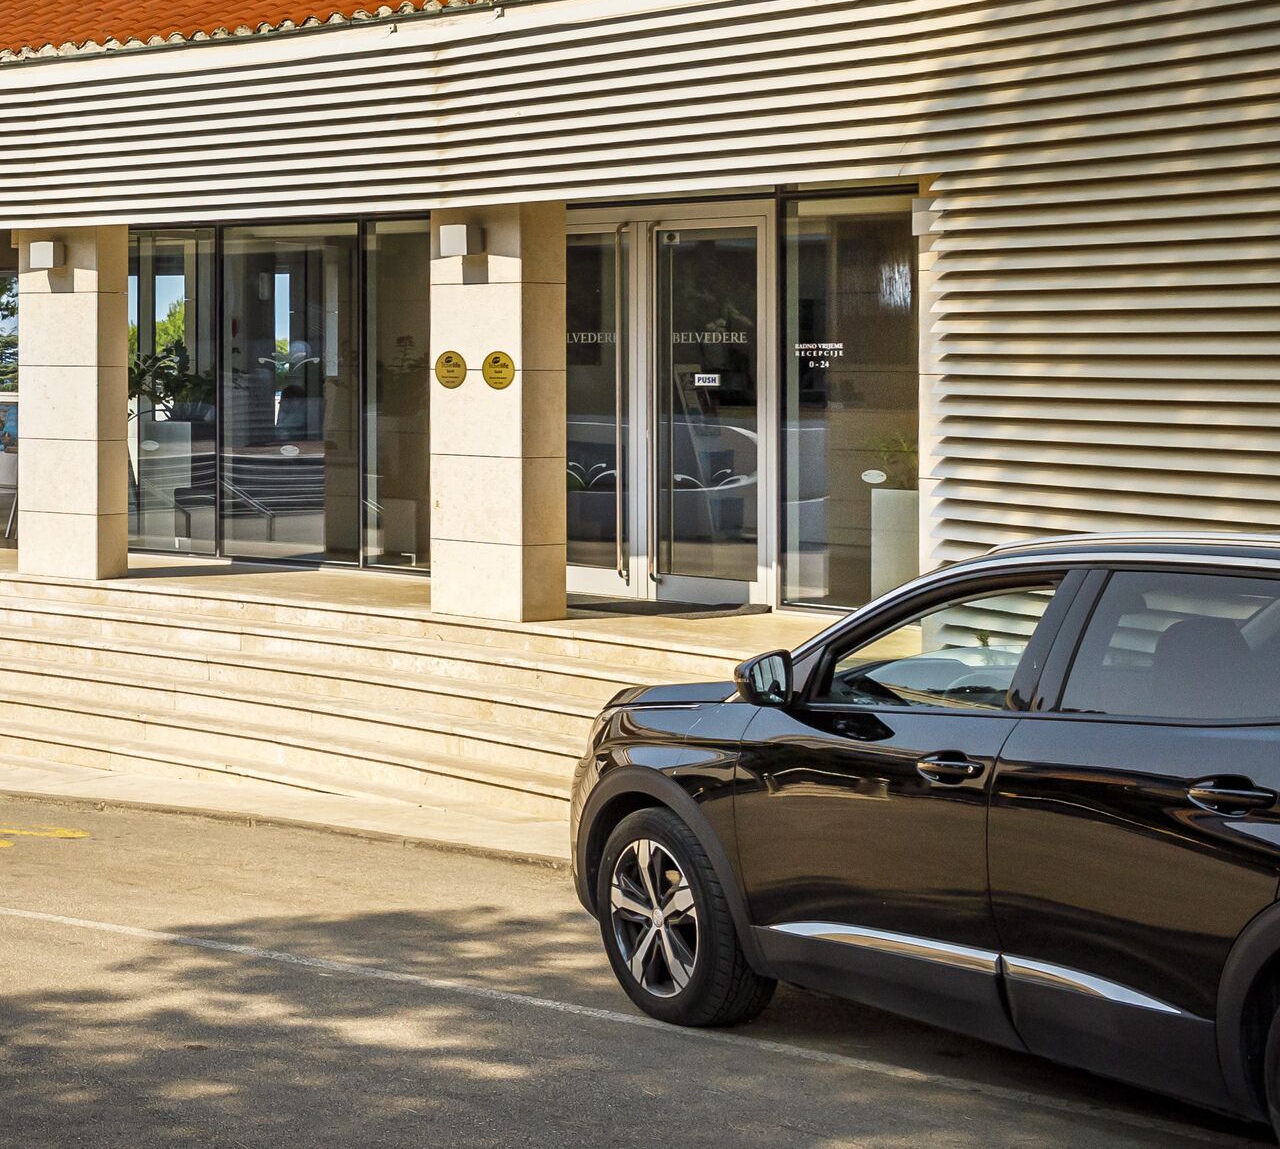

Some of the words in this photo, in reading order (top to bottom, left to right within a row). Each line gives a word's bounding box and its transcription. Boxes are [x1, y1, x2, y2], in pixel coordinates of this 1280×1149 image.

[566, 332, 617, 344] LVEDER
[672, 331, 748, 344] BELVEDERE
[697, 376, 717, 384] PUSH
